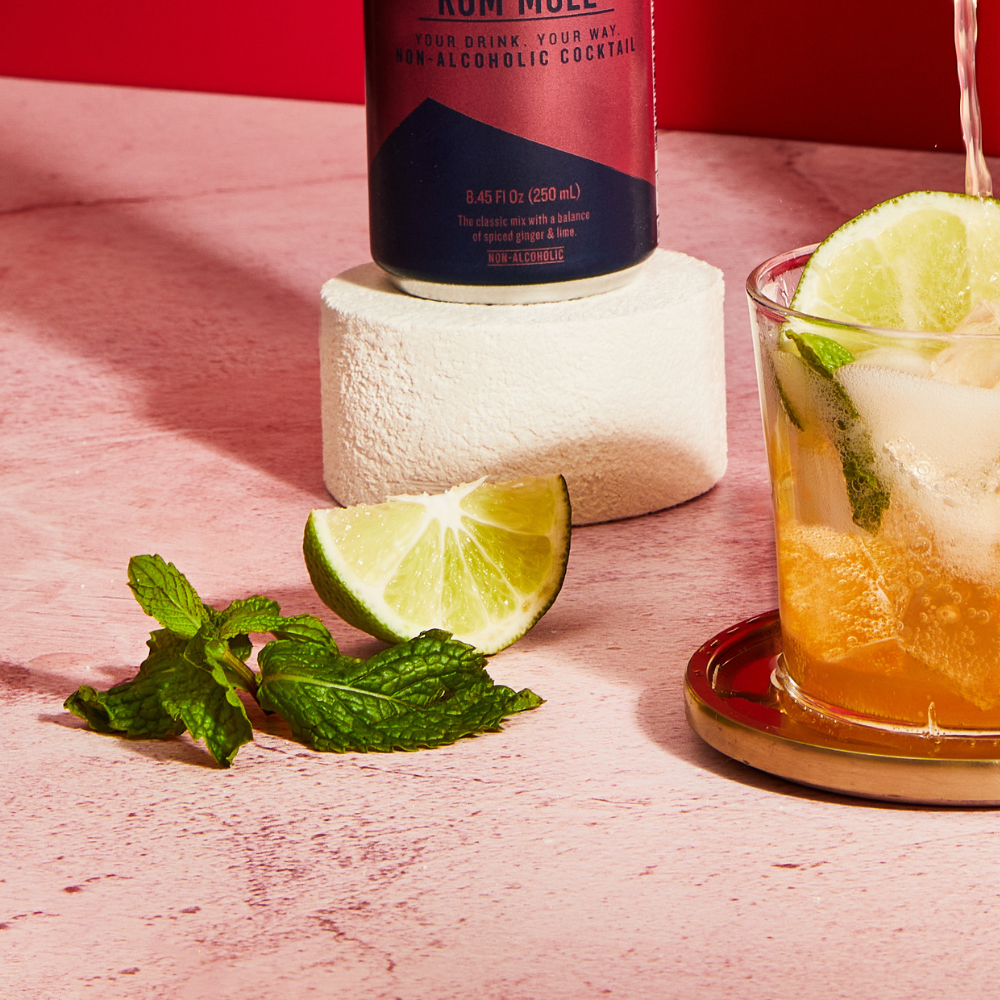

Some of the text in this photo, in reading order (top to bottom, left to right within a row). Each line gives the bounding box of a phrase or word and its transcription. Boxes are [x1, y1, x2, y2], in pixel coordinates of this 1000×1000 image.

[415, 25, 621, 48] YOUR DRINK. YOUR WAY.
[396, 37, 636, 69] NON-ALCOHOLIC COCKTAIL
[466, 189, 492, 204] 8.45
[509, 189, 524, 204] Oz
[528, 187, 556, 205] (250
[559, 182, 581, 201] mL)
[458, 211, 591, 227] The classic mix with a balance
[472, 226, 577, 244] of spiced ginger & lime.
[488, 249, 564, 263] NON-ALCOHOLIC
